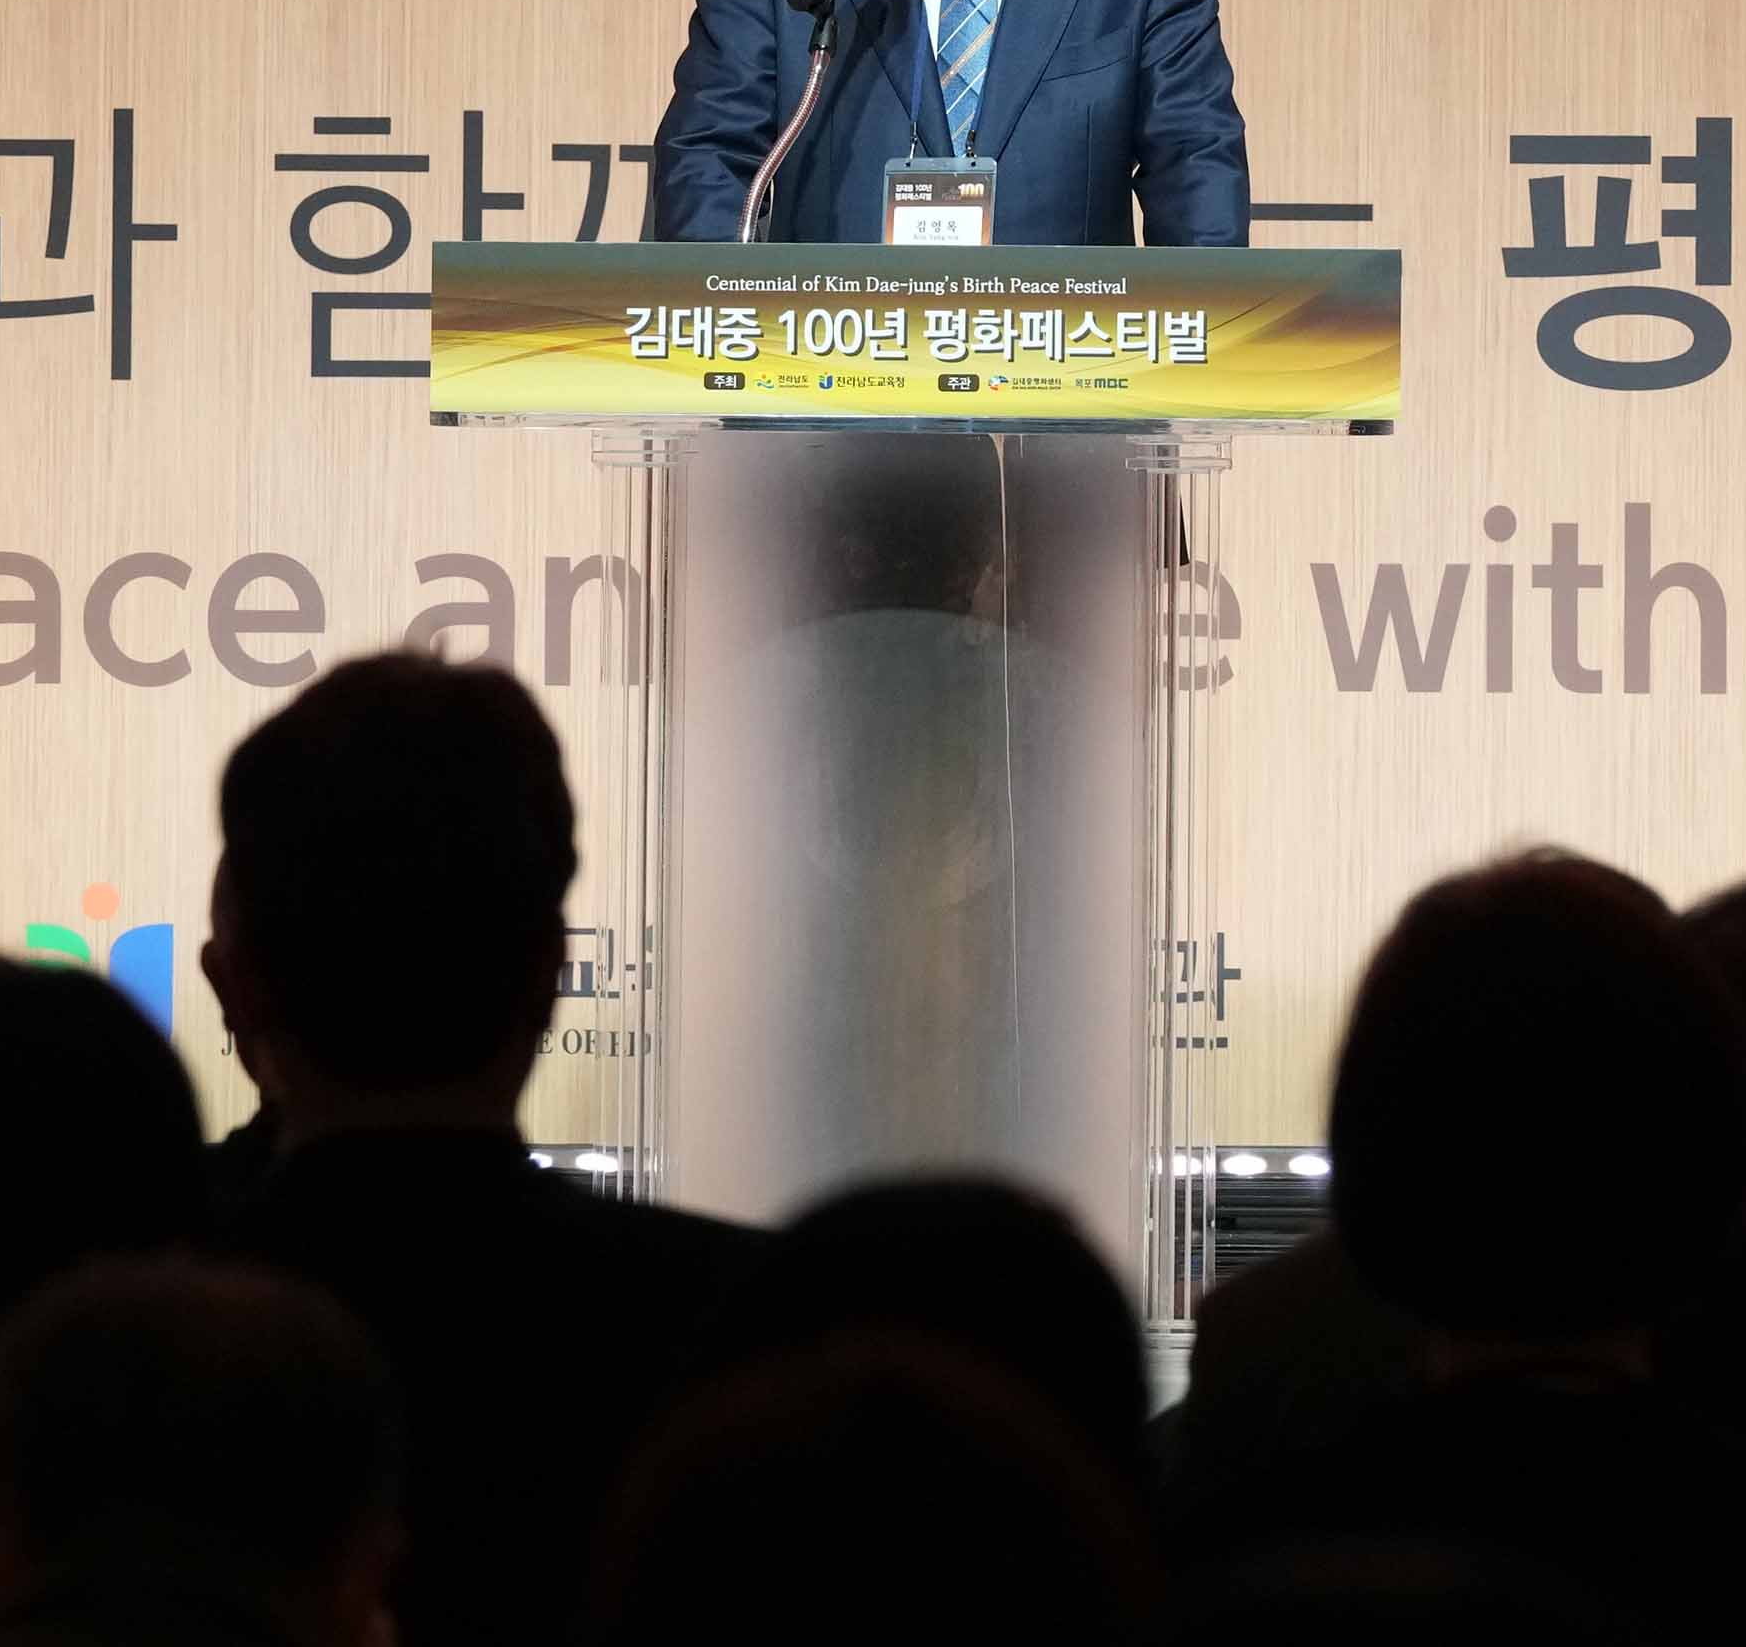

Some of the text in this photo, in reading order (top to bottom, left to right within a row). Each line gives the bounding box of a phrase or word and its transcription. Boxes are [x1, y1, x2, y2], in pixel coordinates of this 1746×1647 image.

[706, 274, 1127, 296] Centennial of Kim Dae-jung's Birth Peace Festival
[625, 306, 1208, 364] 김대중 100년 평화페스티벌
[714, 375, 737, 388] 주최
[947, 377, 972, 390] 주관
[403, 551, 654, 686] an
[1310, 502, 1729, 695] with
